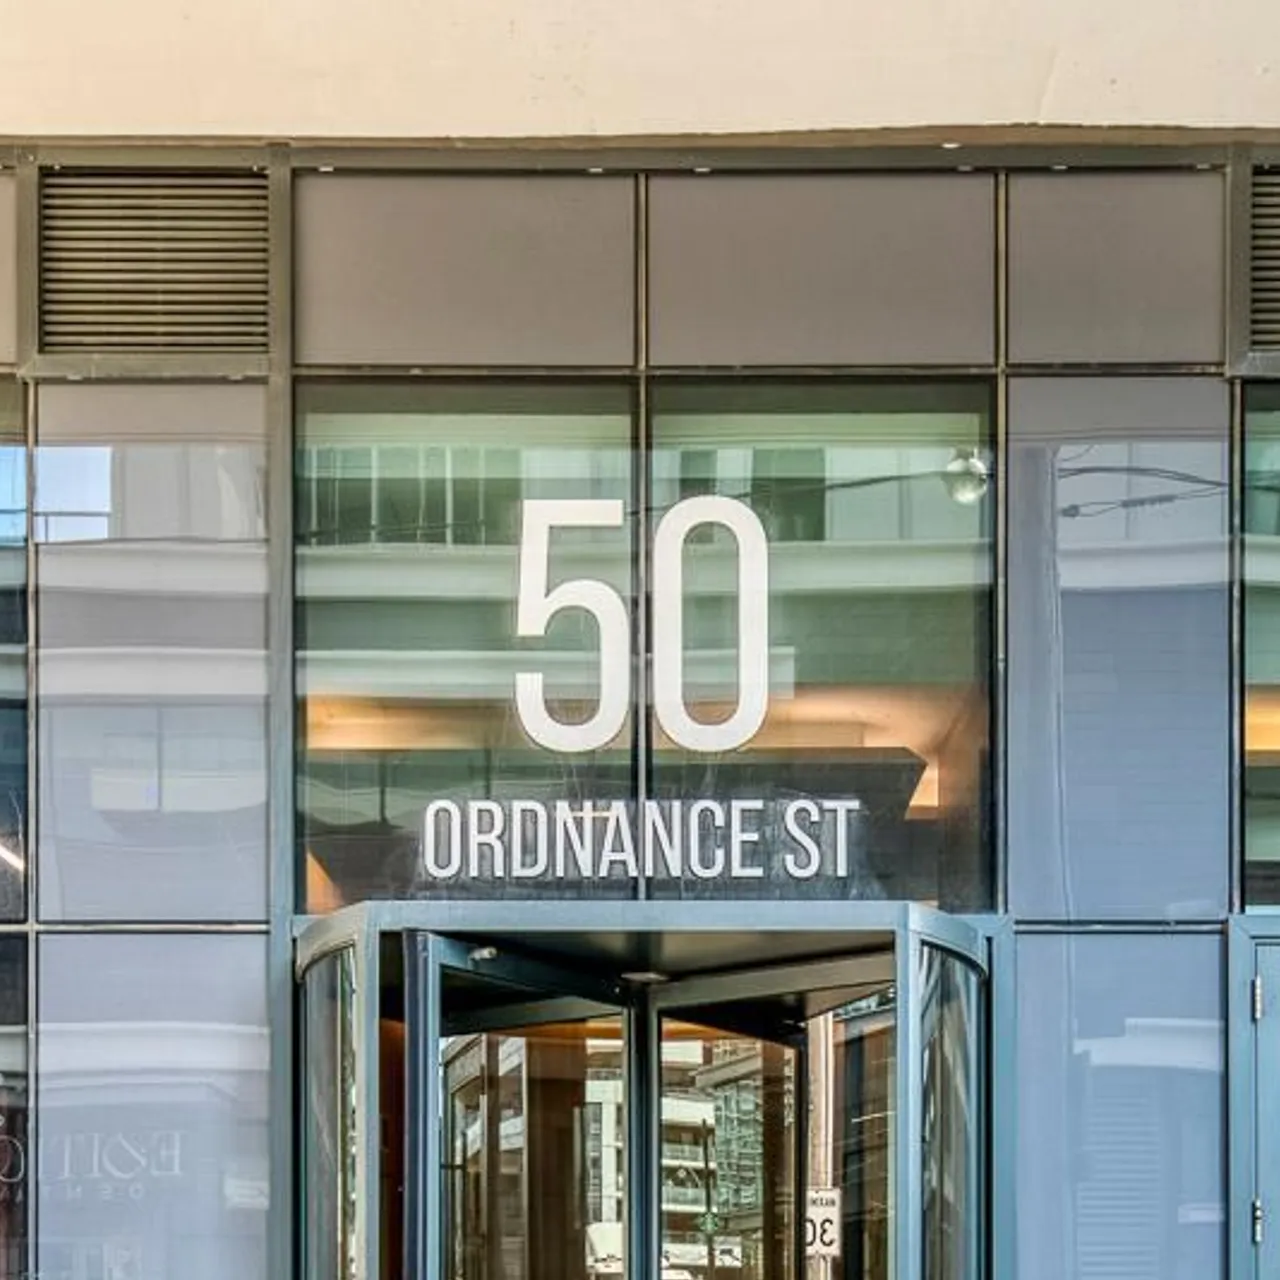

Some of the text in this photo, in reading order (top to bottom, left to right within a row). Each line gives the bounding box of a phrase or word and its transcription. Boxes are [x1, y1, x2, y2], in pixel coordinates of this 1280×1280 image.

[516, 496, 769, 753] 50
[423, 799, 860, 879] ORDNANCE ST
